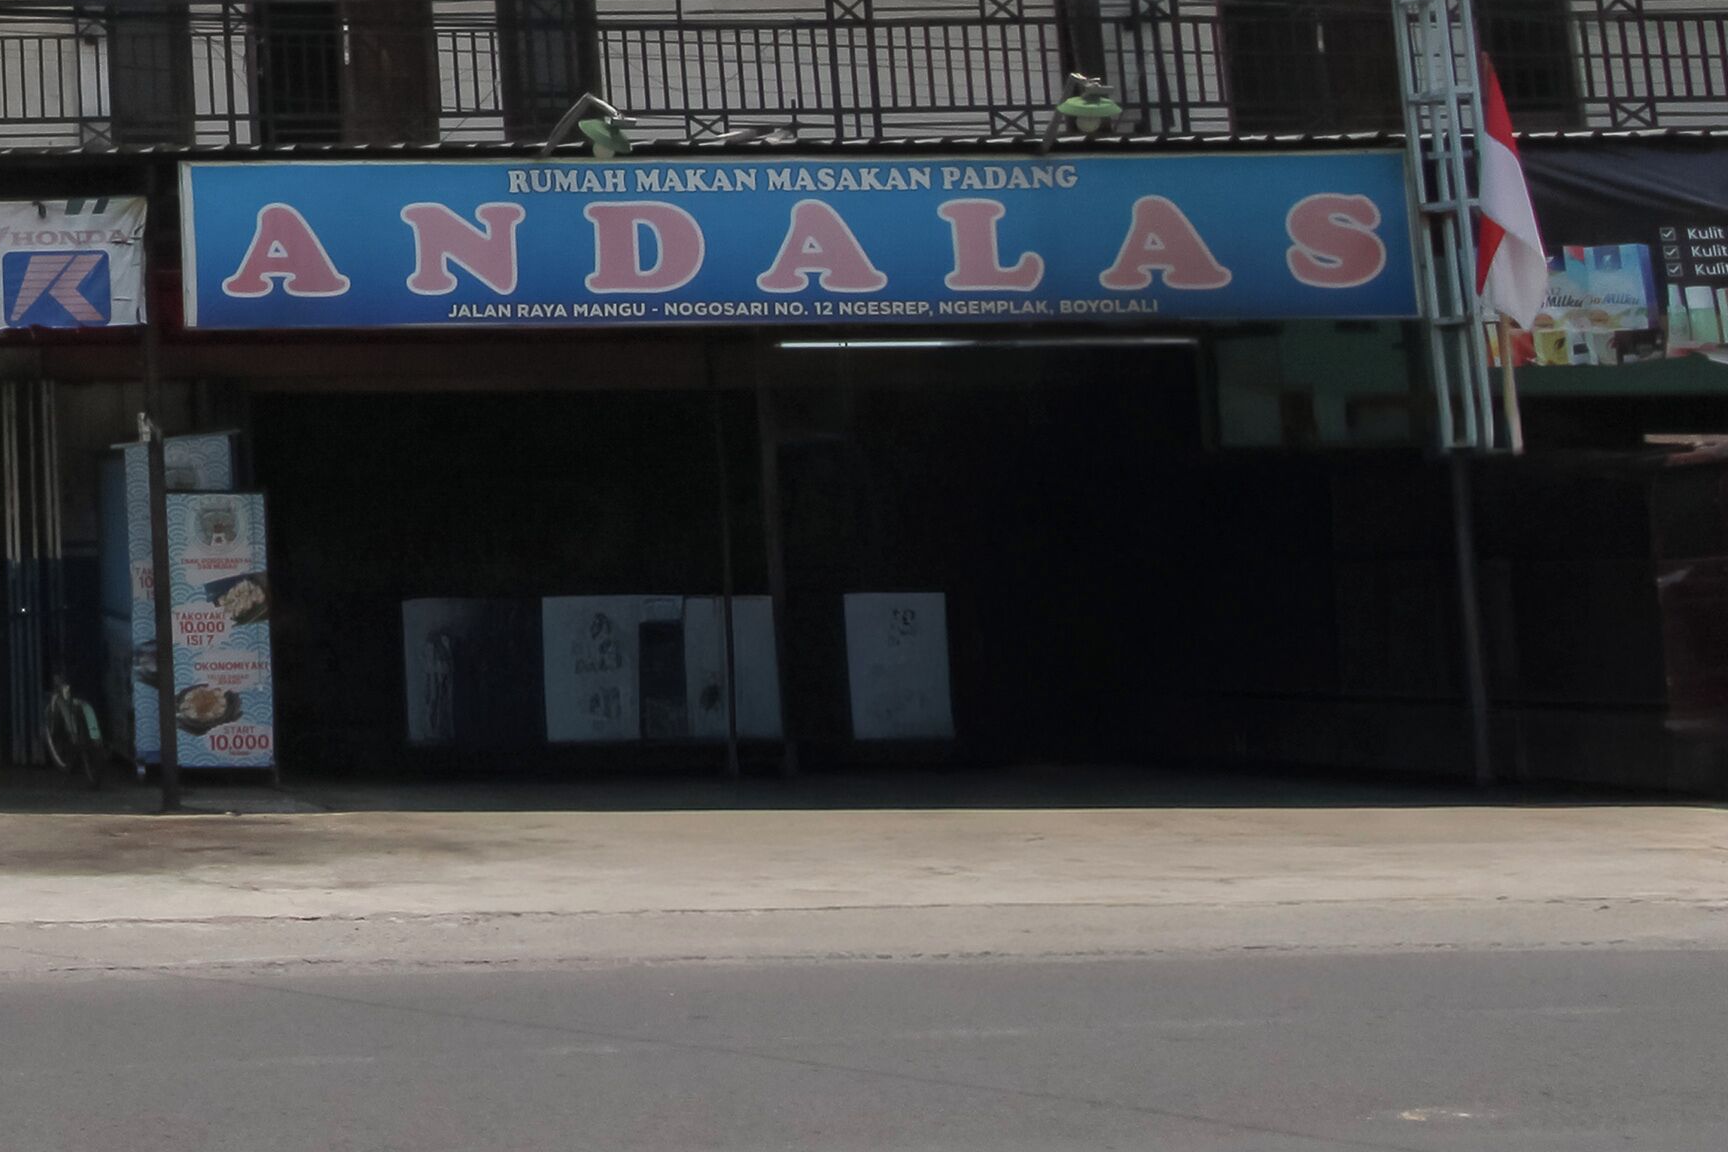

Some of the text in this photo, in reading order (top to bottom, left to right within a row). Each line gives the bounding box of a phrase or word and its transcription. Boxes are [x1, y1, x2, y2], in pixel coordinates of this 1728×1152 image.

[508, 165, 1079, 194] RUMAH MAKAN MASAKAN PADANG
[10, 229, 129, 247] HONDA
[1687, 227, 1725, 239] Kulit
[221, 193, 1387, 299] ANDALAS
[1691, 245, 1728, 257] Kulit
[448, 304, 513, 319] JALAN
[517, 304, 568, 318] RAYA
[573, 303, 647, 318] MANGU
[665, 302, 769, 317] NOGOSARI
[775, 302, 810, 316] NO.
[814, 302, 833, 316] 12
[838, 301, 934, 318] NGESREP,
[938, 300, 1055, 317] NGEMPLAK,
[1059, 299, 1160, 315] BOYOLALI
[176, 612, 225, 621] TAKOYAKI
[179, 621, 225, 634] 10.000
[187, 635, 203, 646] ISI
[194, 661, 269, 671] OKONOMIYAKI
[210, 734, 270, 751] 10.000
